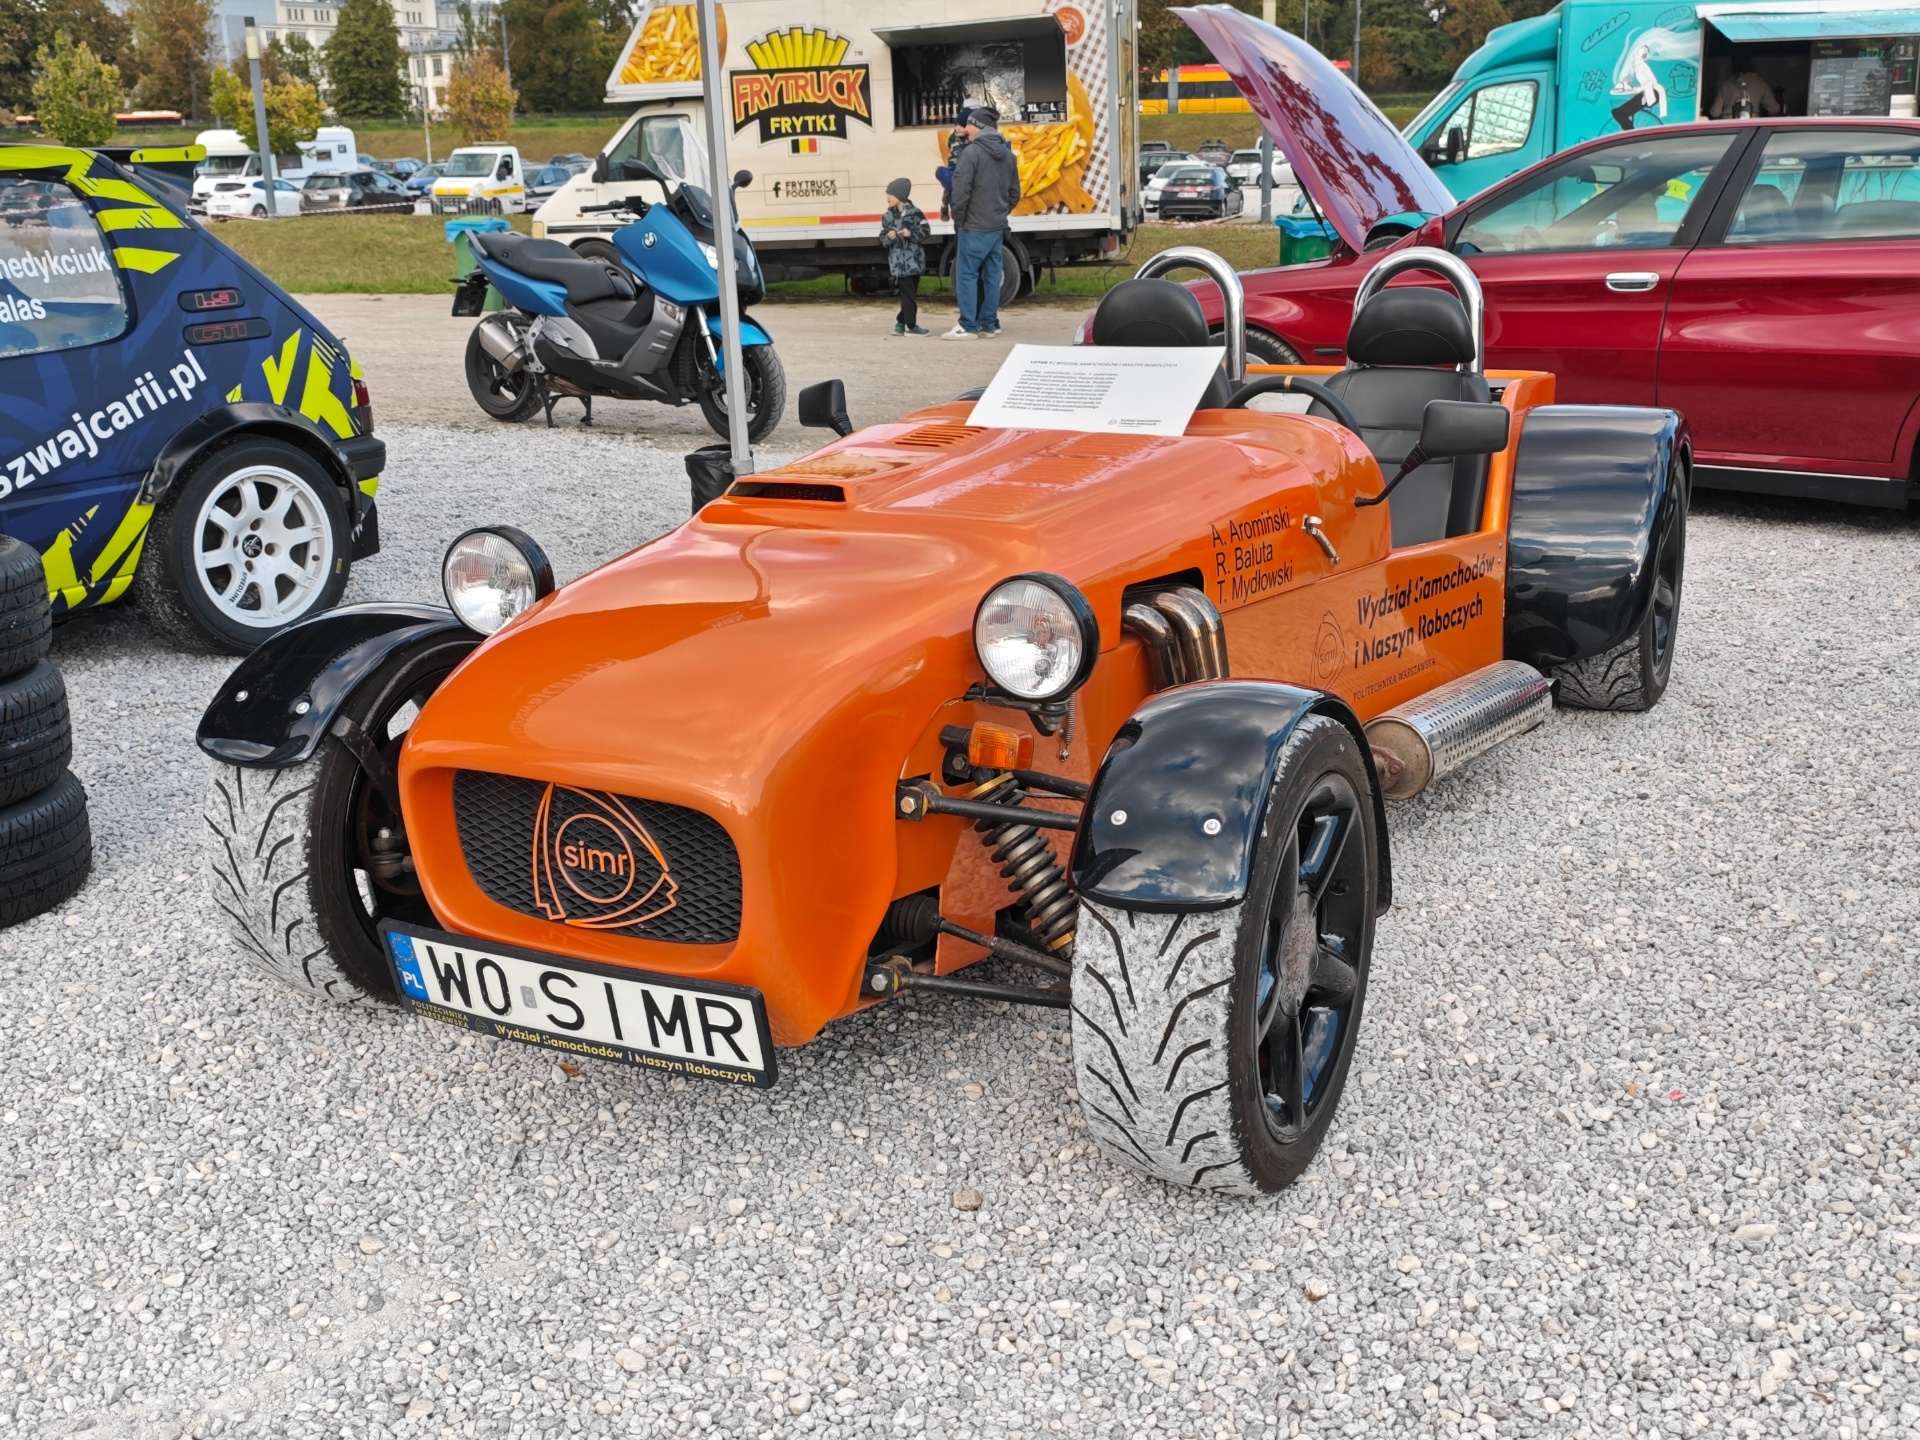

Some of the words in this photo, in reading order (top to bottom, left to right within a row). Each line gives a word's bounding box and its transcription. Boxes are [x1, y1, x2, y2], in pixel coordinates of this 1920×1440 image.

[732, 69, 869, 124] FRYTRUCK
[1027, 103, 1040, 112] XL
[770, 114, 837, 134] FRYTKI
[785, 180, 837, 191] FRYTRUCK
[786, 188, 838, 198] FOODTRUCK
[193, 322, 247, 345] GTI
[1211, 524, 1227, 548] A.
[1229, 505, 1290, 544] Aromiński
[1216, 551, 1230, 577] R.
[1234, 541, 1273, 571] Baluta
[1216, 579, 1227, 604] T.
[1231, 558, 1293, 604] Mydłowski
[1357, 578, 1412, 629] Wydział
[1413, 552, 1495, 604] Samochodów
[1354, 640, 1360, 669] i
[1418, 591, 1483, 641] Roboczych
[1319, 648, 1336, 665] simr
[1353, 674, 1398, 702] POLITECHNIKA
[1398, 658, 1437, 680] WARSZAWSKA
[564, 840, 628, 876] simr
[402, 971, 424, 990] PL
[411, 999, 468, 1021] POLITECHNIKA
[415, 1007, 470, 1029] WARSZAWSKA
[539, 970, 750, 1062] SIMR
[494, 1023, 541, 1042] Wydział
[542, 1034, 623, 1059] Samochodów
[627, 1050, 633, 1062] i
[685, 1061, 756, 1084] Roboczych
